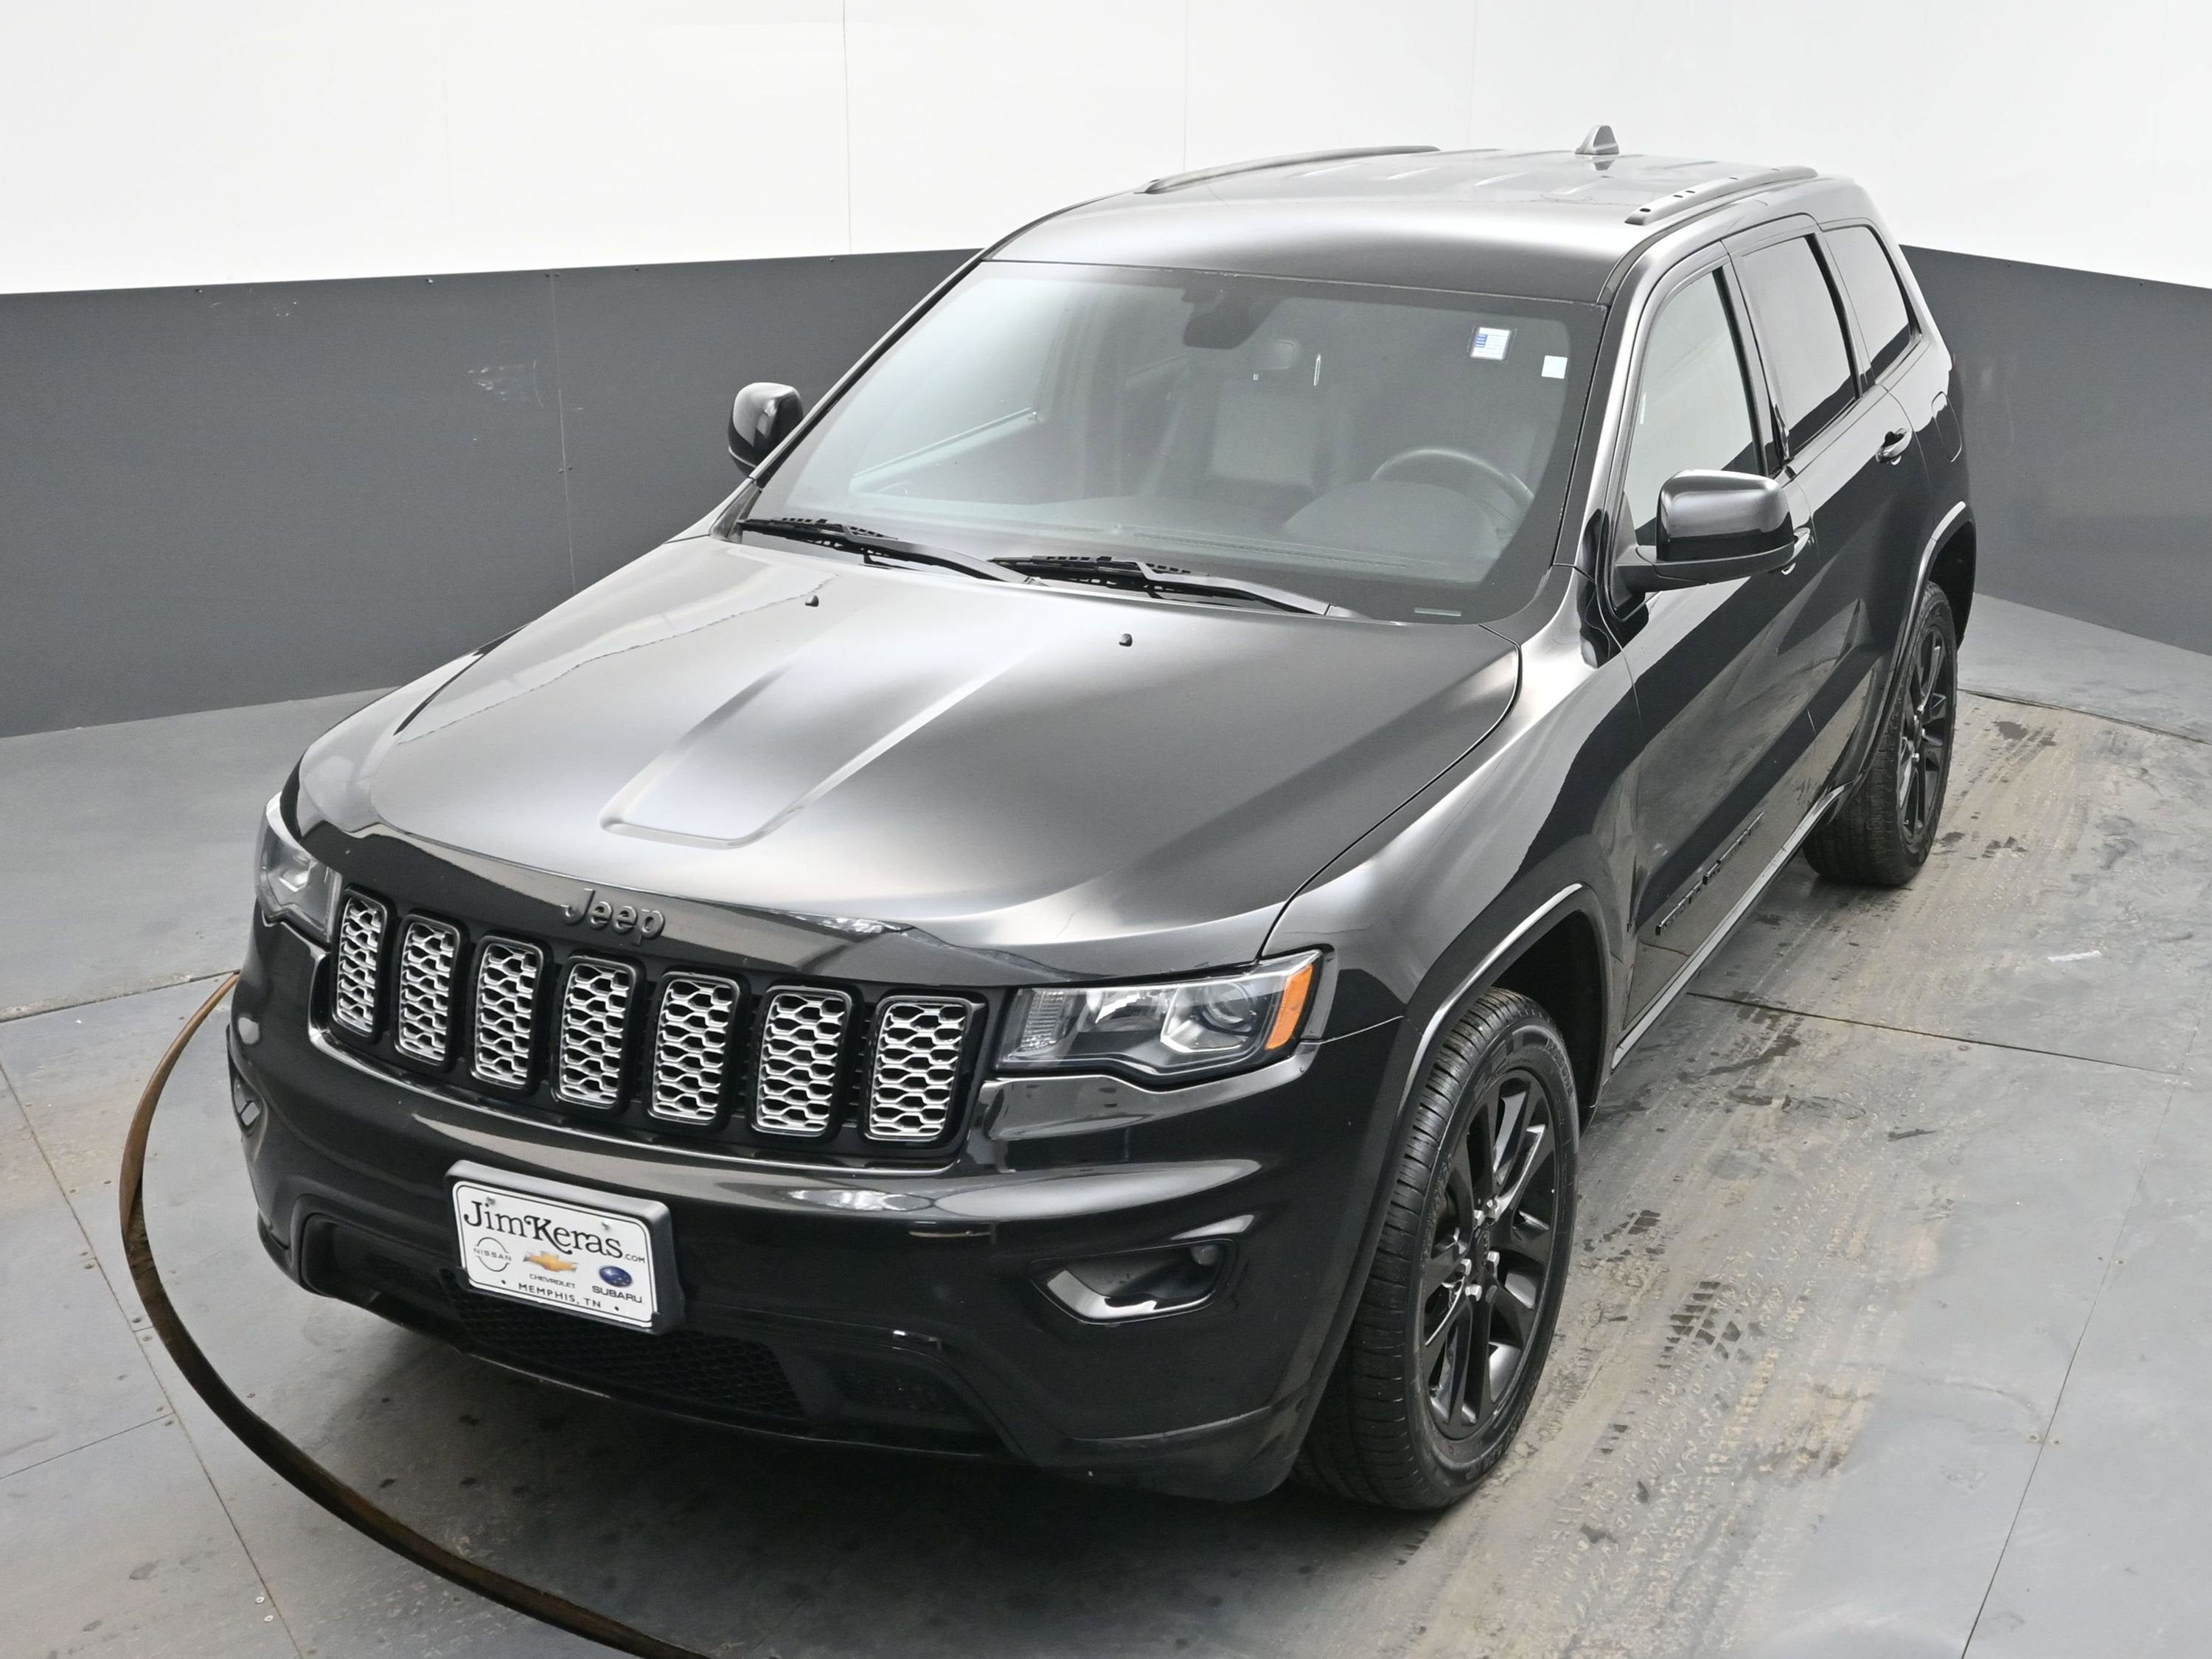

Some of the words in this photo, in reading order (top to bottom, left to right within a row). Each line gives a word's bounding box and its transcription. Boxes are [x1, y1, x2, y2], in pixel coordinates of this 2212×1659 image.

[560, 888, 665, 946] Jeep
[473, 1247, 512, 1262] NISSAN
[529, 1273, 577, 1289] CHEVROLET
[518, 1283, 580, 1305] MEMPHIS,
[583, 1298, 602, 1309] TN
[591, 1285, 643, 1304] SUBARU
